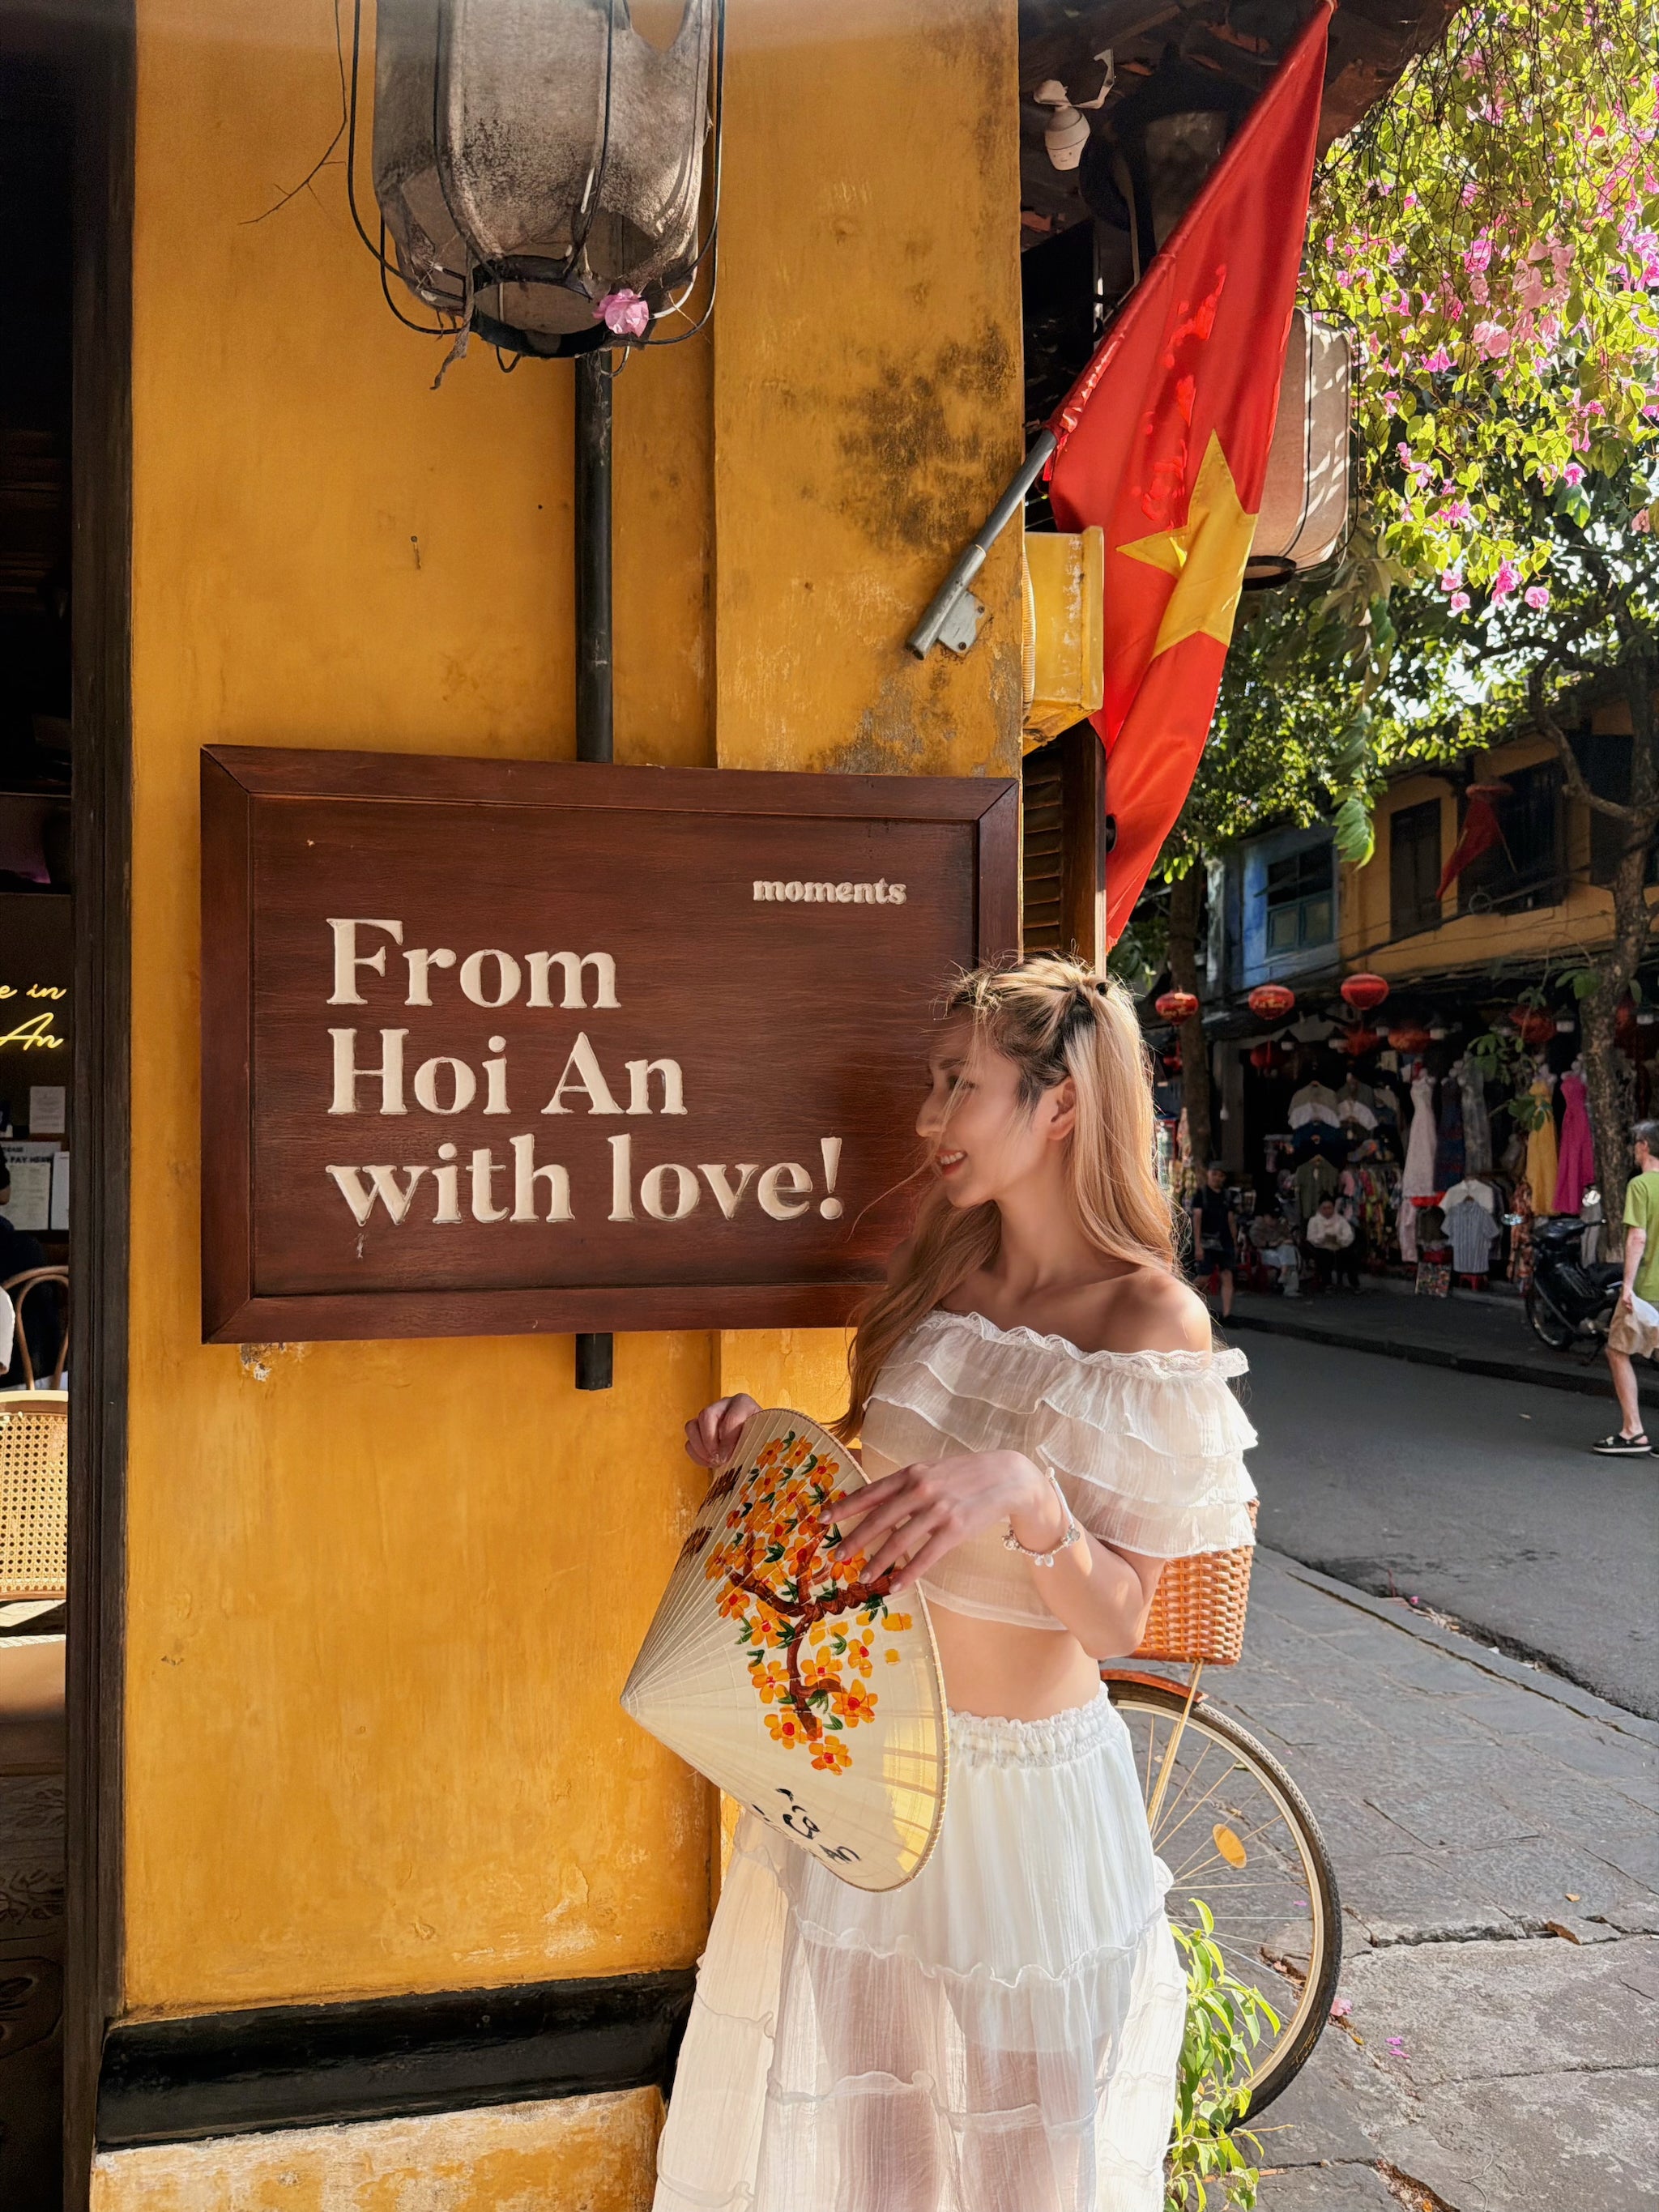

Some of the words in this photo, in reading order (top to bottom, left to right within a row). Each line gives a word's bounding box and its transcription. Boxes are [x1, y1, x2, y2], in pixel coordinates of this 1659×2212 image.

[753, 878, 906, 905] moments
[26, 983, 66, 999] in
[326, 918, 621, 1009] From
[0, 1012, 64, 1051] An
[327, 1028, 511, 1115] Hoi
[540, 1031, 689, 1115] An
[325, 1133, 575, 1227] with
[607, 1133, 842, 1223] love!
